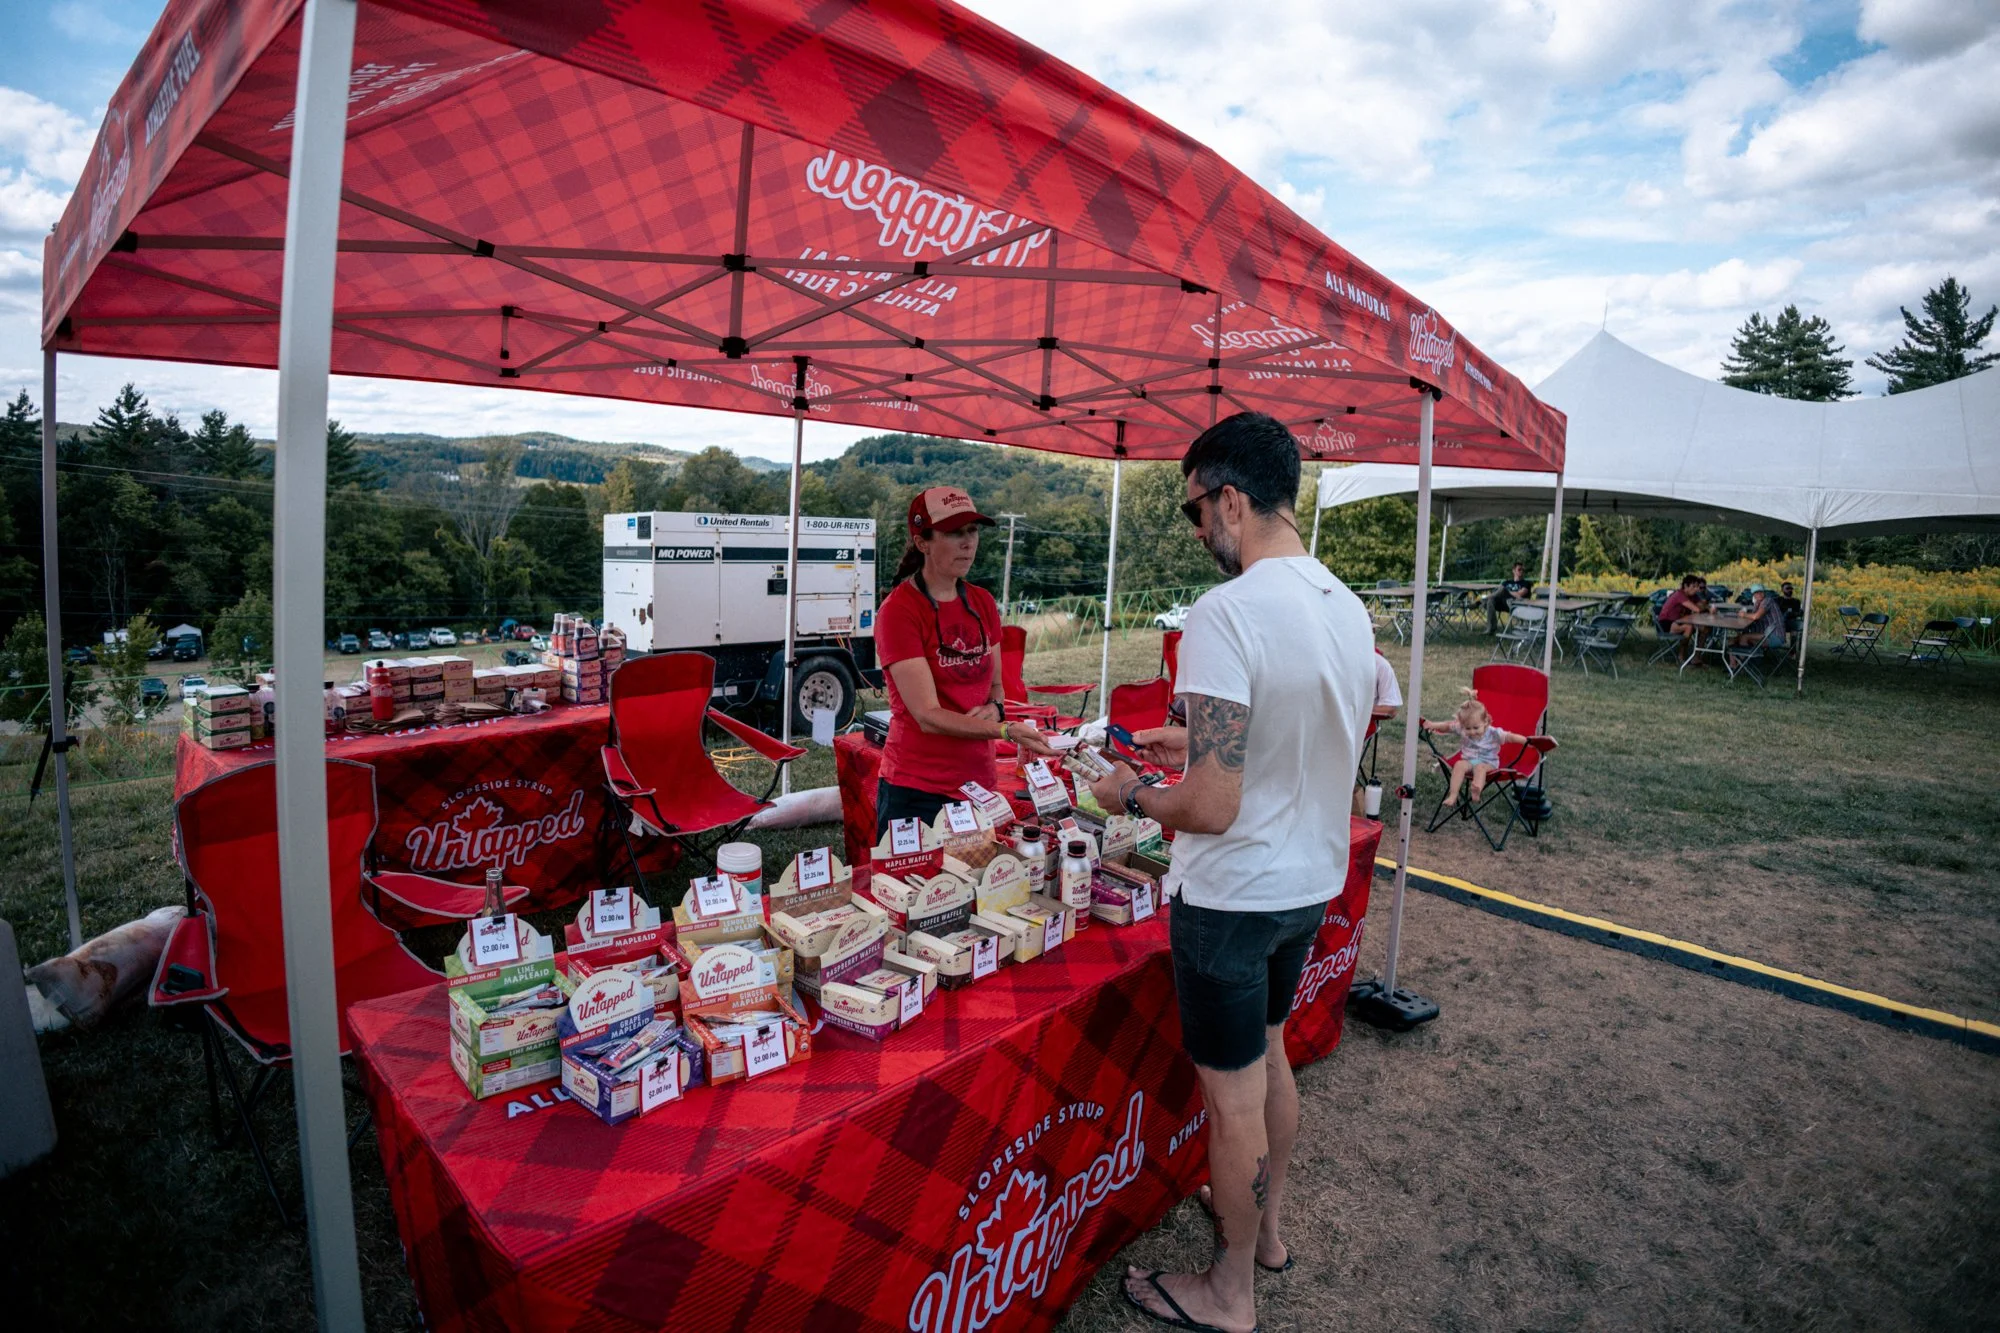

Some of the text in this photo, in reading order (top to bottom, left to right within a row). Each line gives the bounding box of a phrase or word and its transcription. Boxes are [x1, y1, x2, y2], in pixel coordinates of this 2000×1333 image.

[145, 29, 201, 149] ATHLETIC FUEL
[1325, 271, 1391, 322] ALL NATURAL
[1409, 311, 1458, 376] Untapped
[709, 517, 770, 528] United Rentals
[805, 520, 871, 531] 1-800-UR-RENTS
[657, 549, 712, 559] MQ POWER
[835, 550, 849, 560] 25
[441, 779, 553, 811] SLOPESIDE SYRUP
[405, 790, 585, 873] Untapped
[885, 860, 907, 869] MAPLE
[908, 853, 933, 865] WAFFLE
[804, 870, 825, 881] $2.25 /ea
[705, 898, 718, 906] $2.00
[785, 886, 838, 906] COCOA WAFFLE
[926, 883, 957, 906] Untapped
[600, 914, 615, 924] $2.00
[723, 918, 743, 928] LEMON
[919, 909, 963, 928] COFFEE WAFFLE
[1328, 914, 1350, 929] SYRUP
[678, 925, 693, 933] LIQUID
[482, 943, 510, 954] $2.00 /ea
[569, 939, 610, 953] LIQUID DRINK MIX
[615, 933, 657, 948] MAPLEAID
[517, 964, 535, 974] LIME
[826, 944, 881, 978] RASPBERRY WAFFLE
[450, 970, 497, 986] LIQUID DRINK MIX
[503, 968, 550, 985] MAPLEAID
[698, 956, 754, 989] Untapped
[577, 980, 635, 1021] Untapped
[684, 995, 727, 1010] LIQUID DRINK MIX
[732, 993, 773, 1009] MAPLEAID
[739, 989, 764, 1000] GINGER
[833, 1000, 865, 1016] Untapped
[592, 1017, 610, 1026] NATURAL
[611, 1018, 650, 1039] MAPLEAID
[620, 1015, 641, 1029] GRAPE
[824, 1013, 875, 1036] RASPBERRY WAFFLE
[562, 1025, 606, 1047] LIQUID DRINK MIX
[525, 1040, 559, 1053] MAPLEAI
[754, 1050, 779, 1065] $2.00 /ea
[649, 1084, 672, 1099] $2.00 /ea
[507, 1086, 571, 1119] ALL
[1168, 1109, 1209, 1156] ATHLE
[958, 1102, 1105, 1221] SLOPESIDE SYRUP
[909, 1090, 1145, 1333] Untapped
